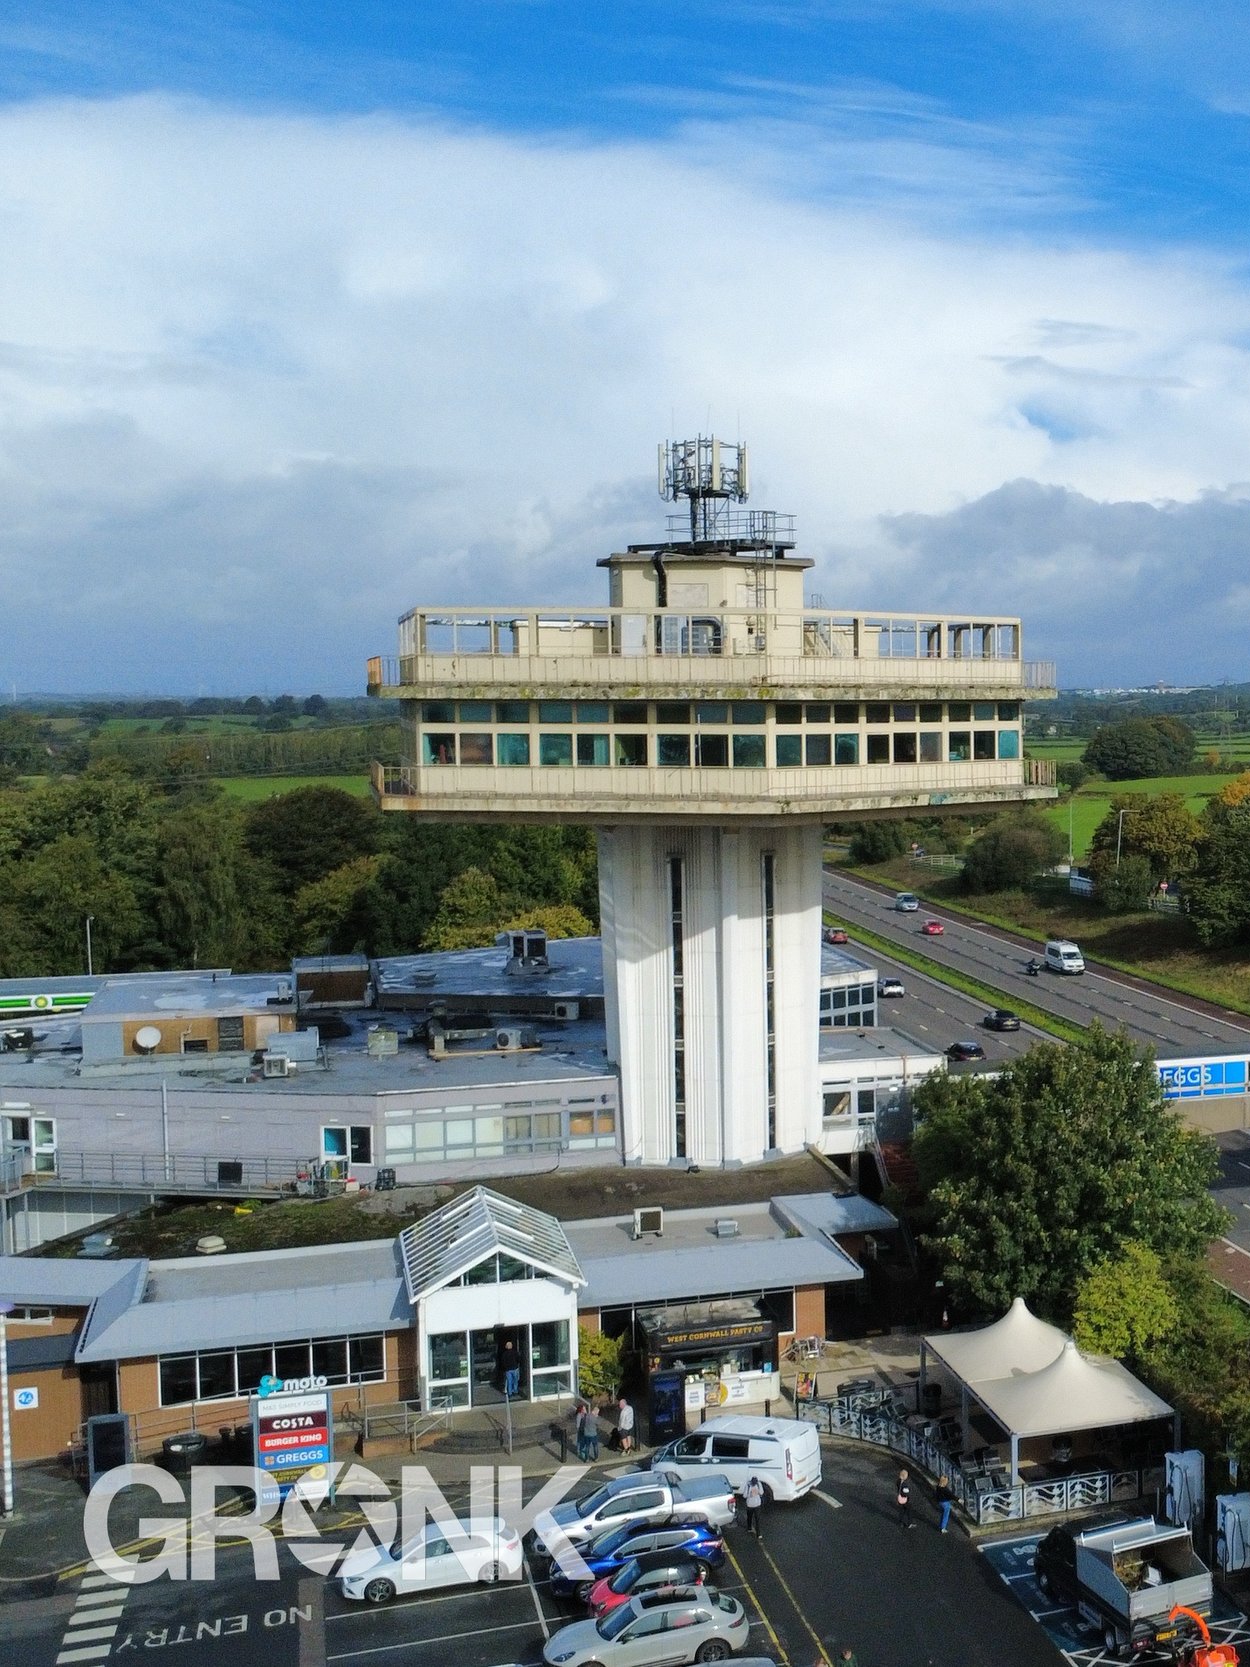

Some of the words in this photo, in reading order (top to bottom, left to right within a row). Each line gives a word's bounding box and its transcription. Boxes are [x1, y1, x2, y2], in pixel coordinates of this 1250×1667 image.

[667, 1335, 688, 1343] WEST
[688, 1330, 729, 1340] CORNWALL
[283, 1376, 327, 1391] moto
[272, 1417, 313, 1429] COSTA
[265, 1437, 298, 1447] BURGER
[300, 1434, 321, 1442] KING
[277, 1450, 323, 1463] GREGGS
[263, 1604, 312, 1627] NO
[116, 1614, 249, 1653] ENTRY
